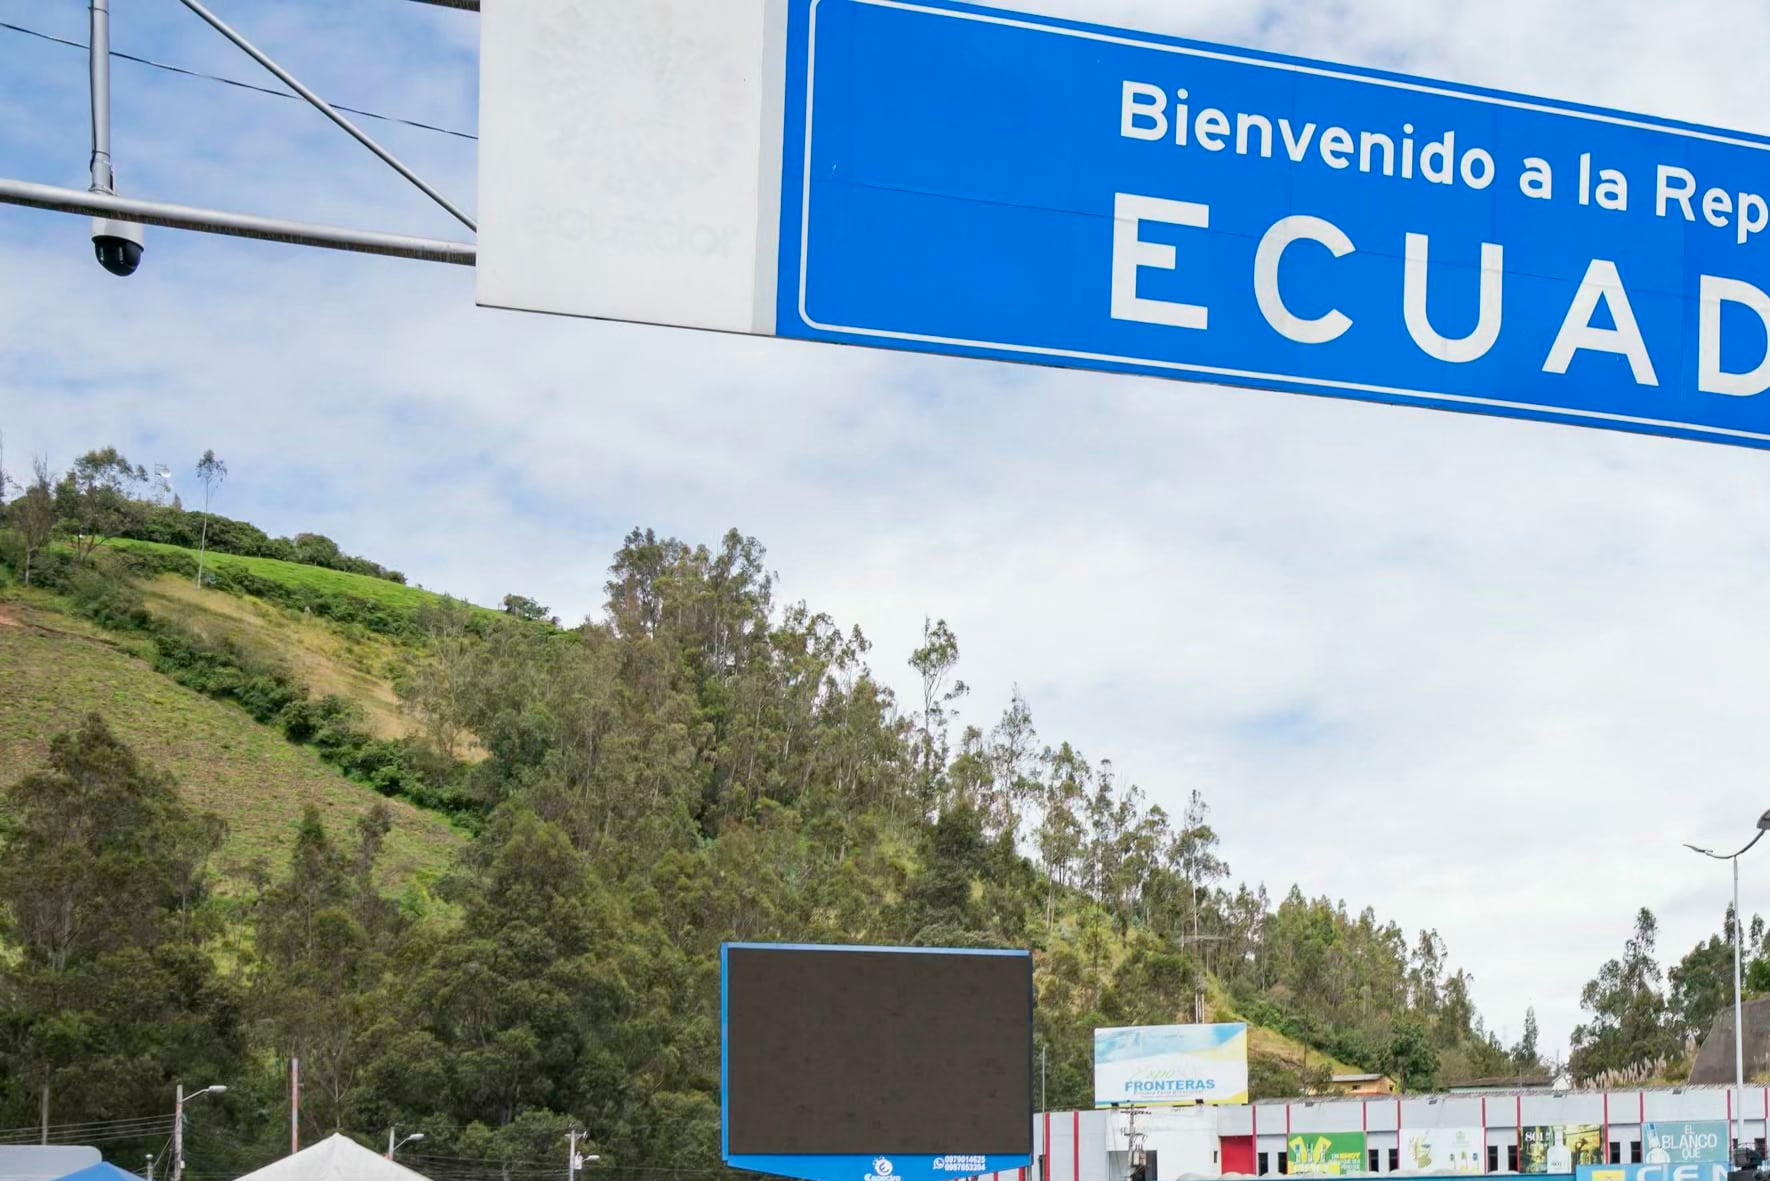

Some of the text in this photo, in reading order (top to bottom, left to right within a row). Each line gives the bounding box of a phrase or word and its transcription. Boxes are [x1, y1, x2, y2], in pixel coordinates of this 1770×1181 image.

[1120, 80, 1495, 189] Bienvenido
[1519, 157, 1552, 199] a
[1579, 153, 1627, 211] la
[1124, 1079, 1216, 1093] FRONTERAS
[1684, 1124, 1695, 1134] EL
[1661, 1133, 1718, 1149] BLANCO
[1682, 1148, 1701, 1160] QUE
